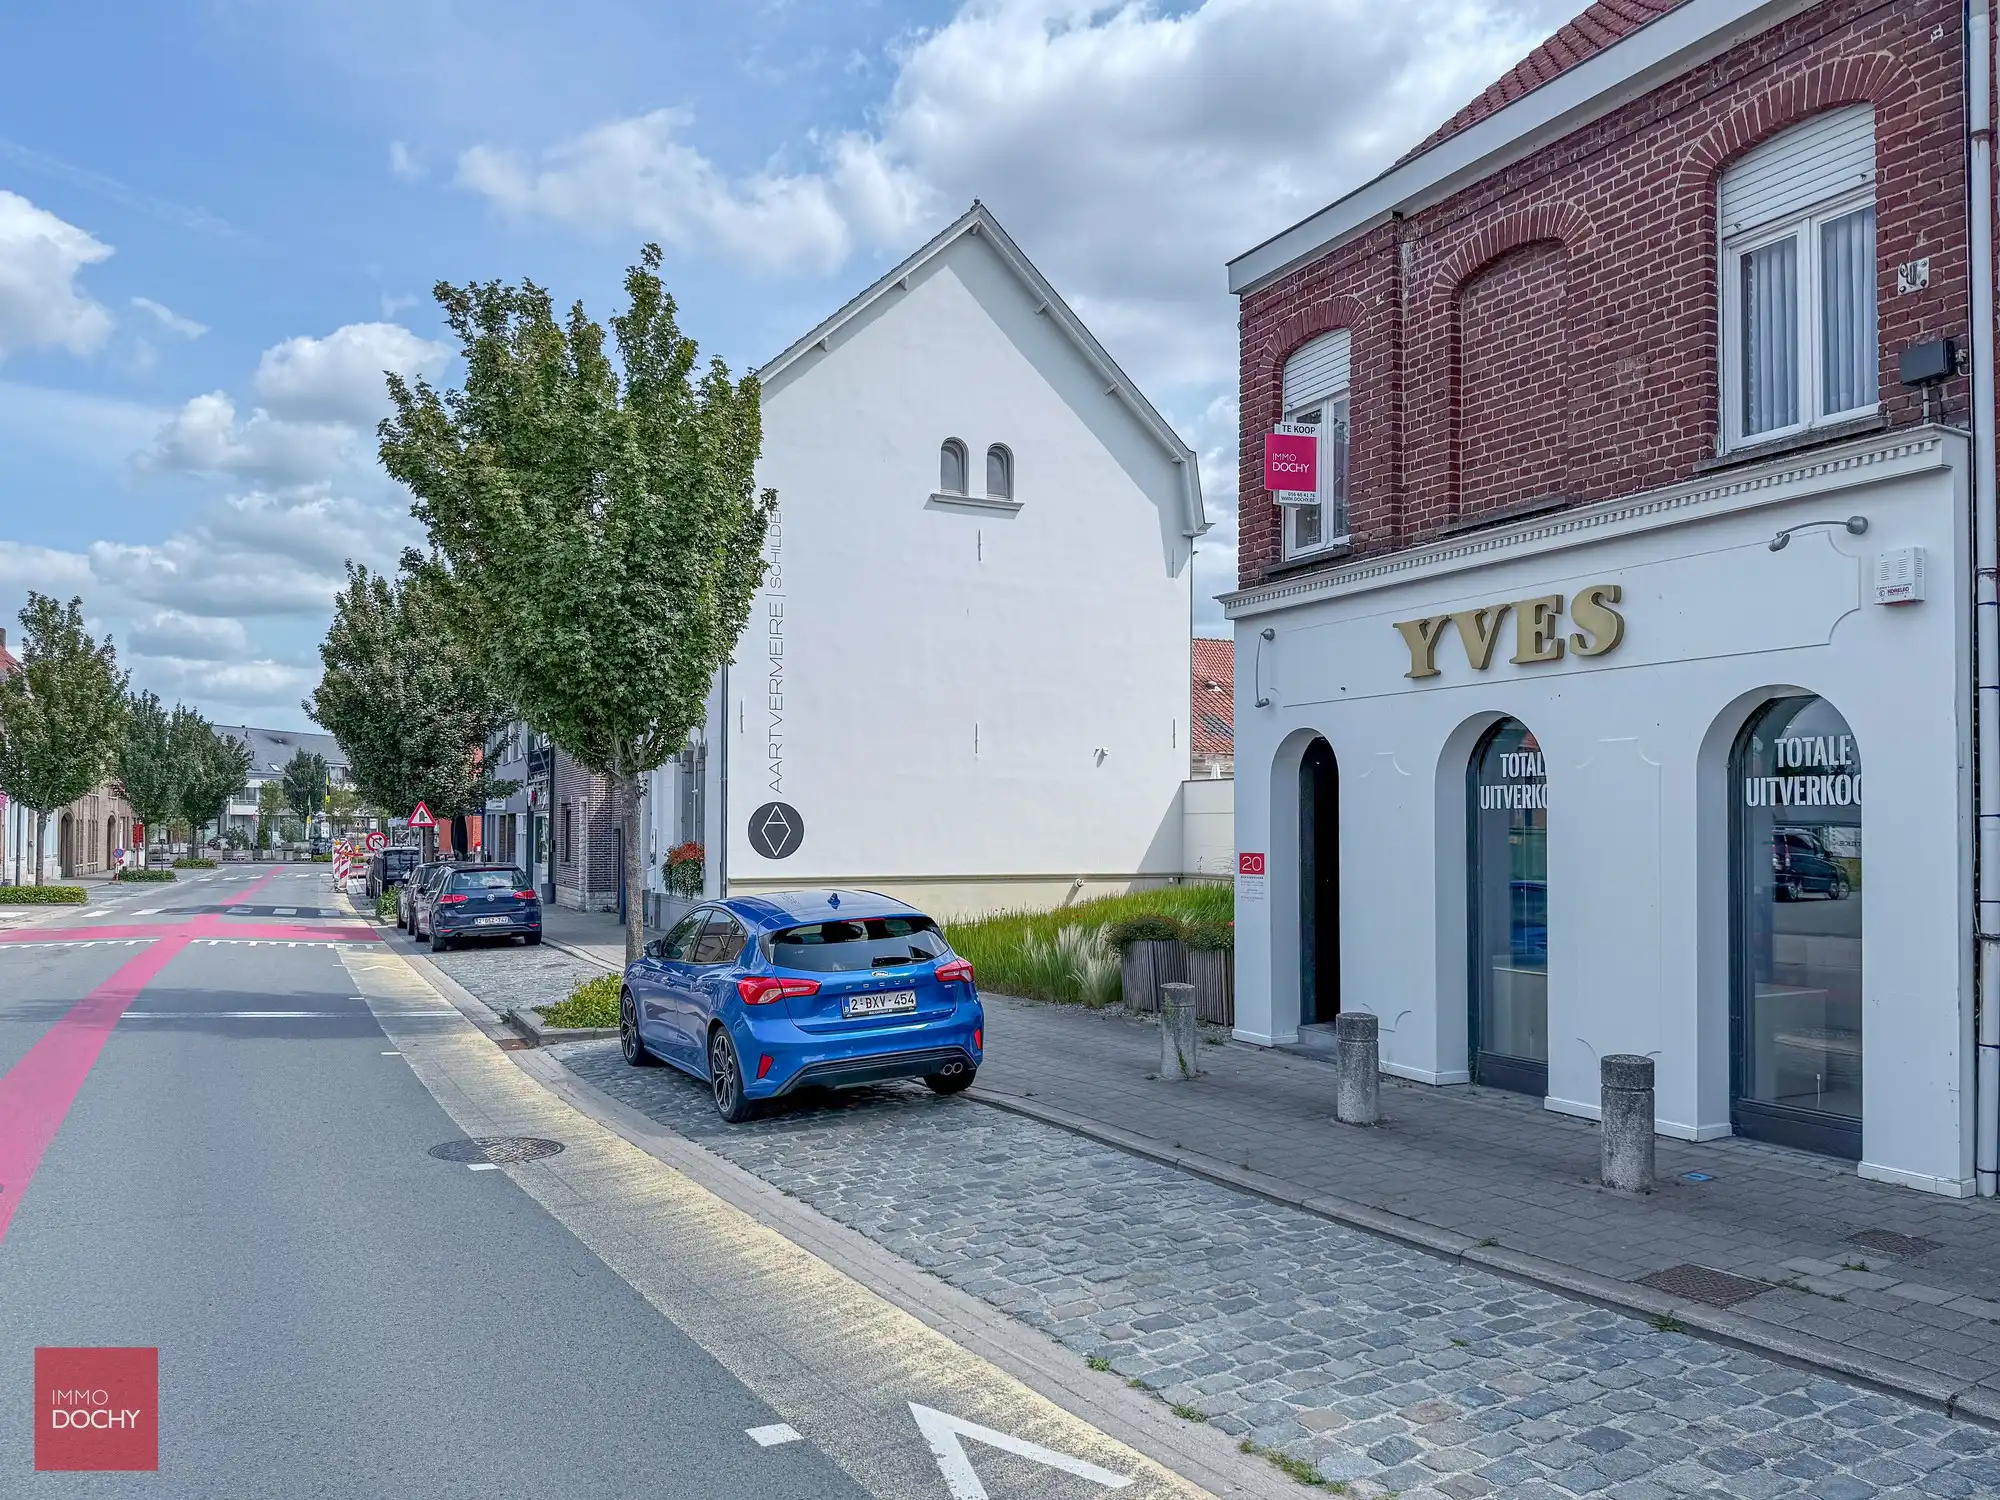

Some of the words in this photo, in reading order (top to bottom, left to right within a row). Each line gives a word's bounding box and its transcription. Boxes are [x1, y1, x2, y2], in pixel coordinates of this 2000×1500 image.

[1282, 424, 1292, 433] TE
[1294, 425, 1315, 434] KOOP
[1272, 453, 1296, 462] IMMO
[1272, 462, 1310, 473] DOCHY
[1393, 585, 1625, 679] YVES
[768, 602, 784, 794] AARTVERMEIRE
[1774, 735, 1852, 768] TOTALE
[1500, 752, 1547, 778] TOTAL
[1241, 856, 1262, 872] 20
